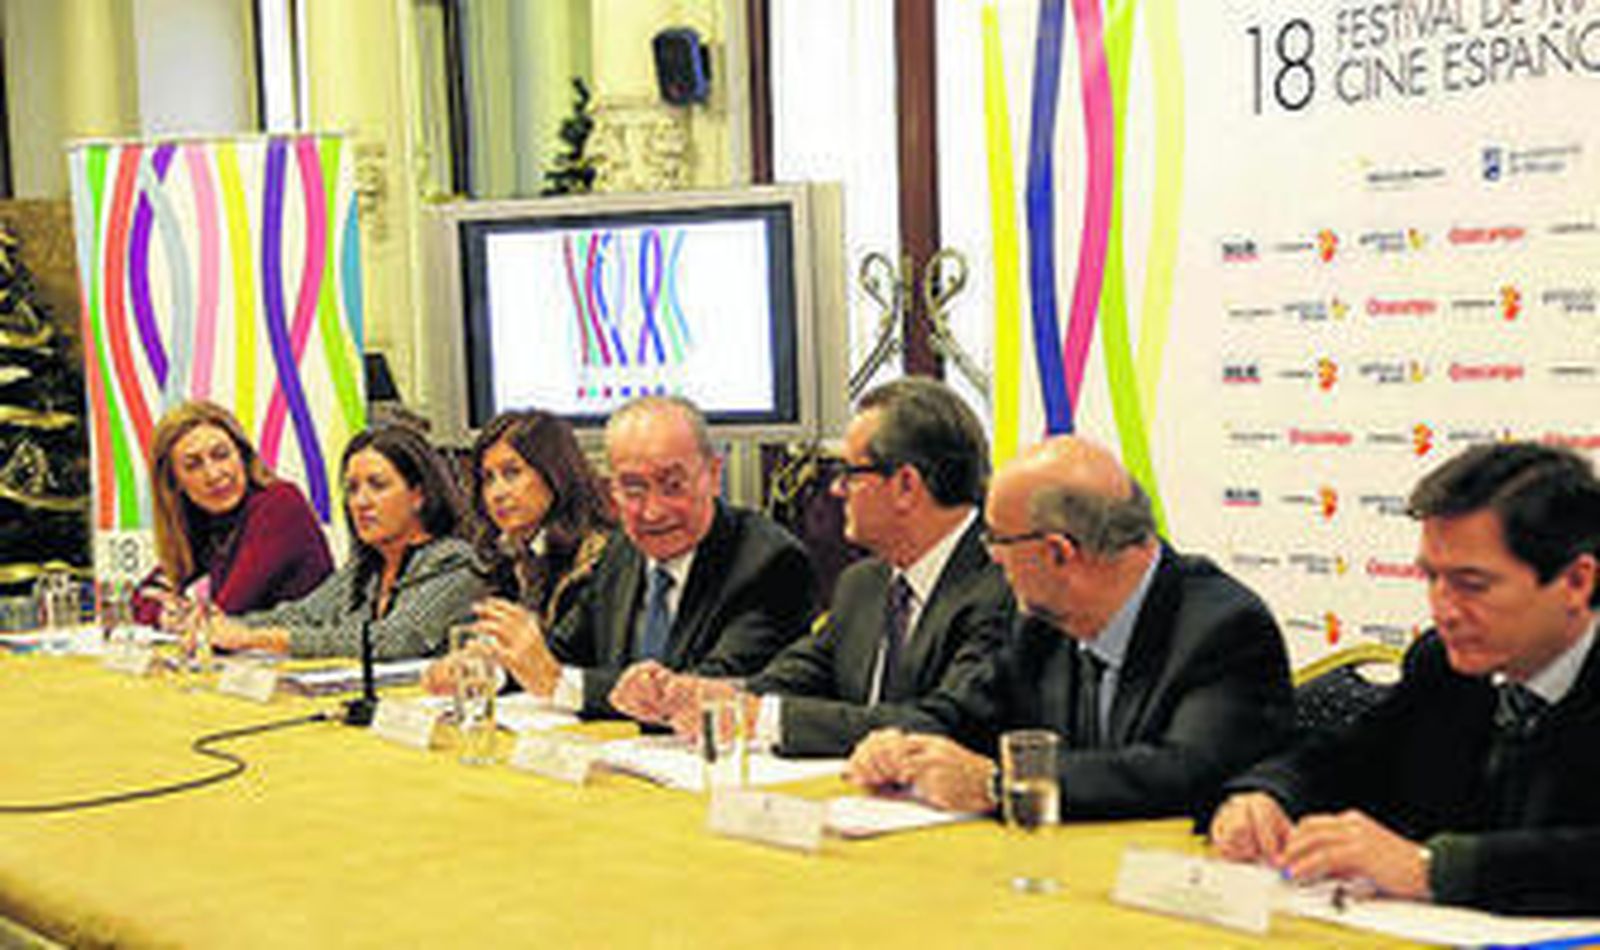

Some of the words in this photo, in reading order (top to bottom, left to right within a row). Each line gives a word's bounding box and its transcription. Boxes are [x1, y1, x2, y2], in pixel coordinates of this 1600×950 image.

[1336, 0, 1468, 52] FESTIVAL
[1246, 17, 1316, 115] 18
[1335, 46, 1428, 106] CINE
